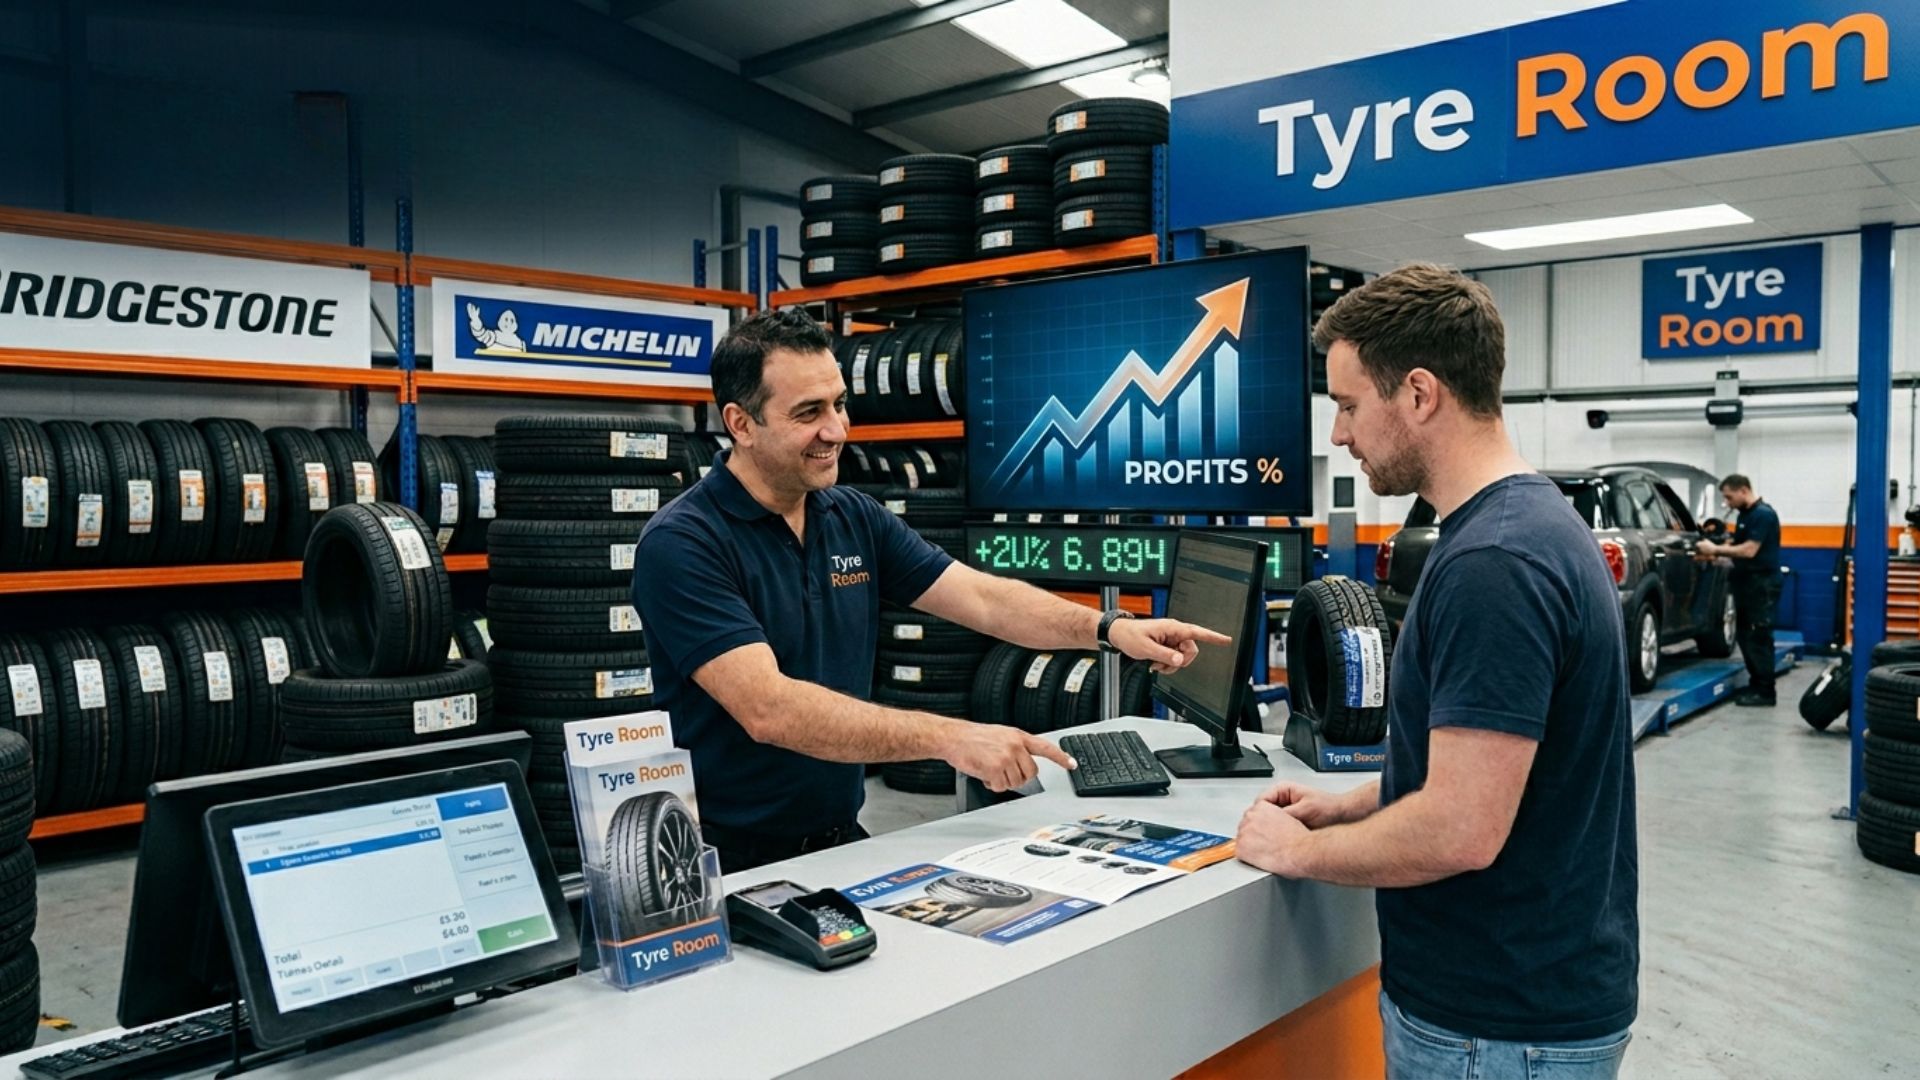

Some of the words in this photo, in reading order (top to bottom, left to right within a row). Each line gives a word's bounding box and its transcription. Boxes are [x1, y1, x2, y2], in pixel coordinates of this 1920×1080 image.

[1257, 88, 1475, 190] Tyre
[1516, 11, 1890, 139] Room
[0, 268, 338, 337] RIDGESTONE
[1675, 265, 1786, 310] Tyre
[532, 322, 702, 358] MICHELIN
[1659, 312, 1804, 349] Room
[1124, 458, 1249, 486] PROFITS
[1257, 456, 1284, 484] %
[831, 555, 863, 573] Tyre
[577, 730, 614, 751] Tyre
[618, 722, 665, 743] Room
[598, 769, 636, 792] Tyre
[639, 761, 686, 783] Room
[631, 947, 670, 972] Tyre
[672, 932, 721, 958] Room
